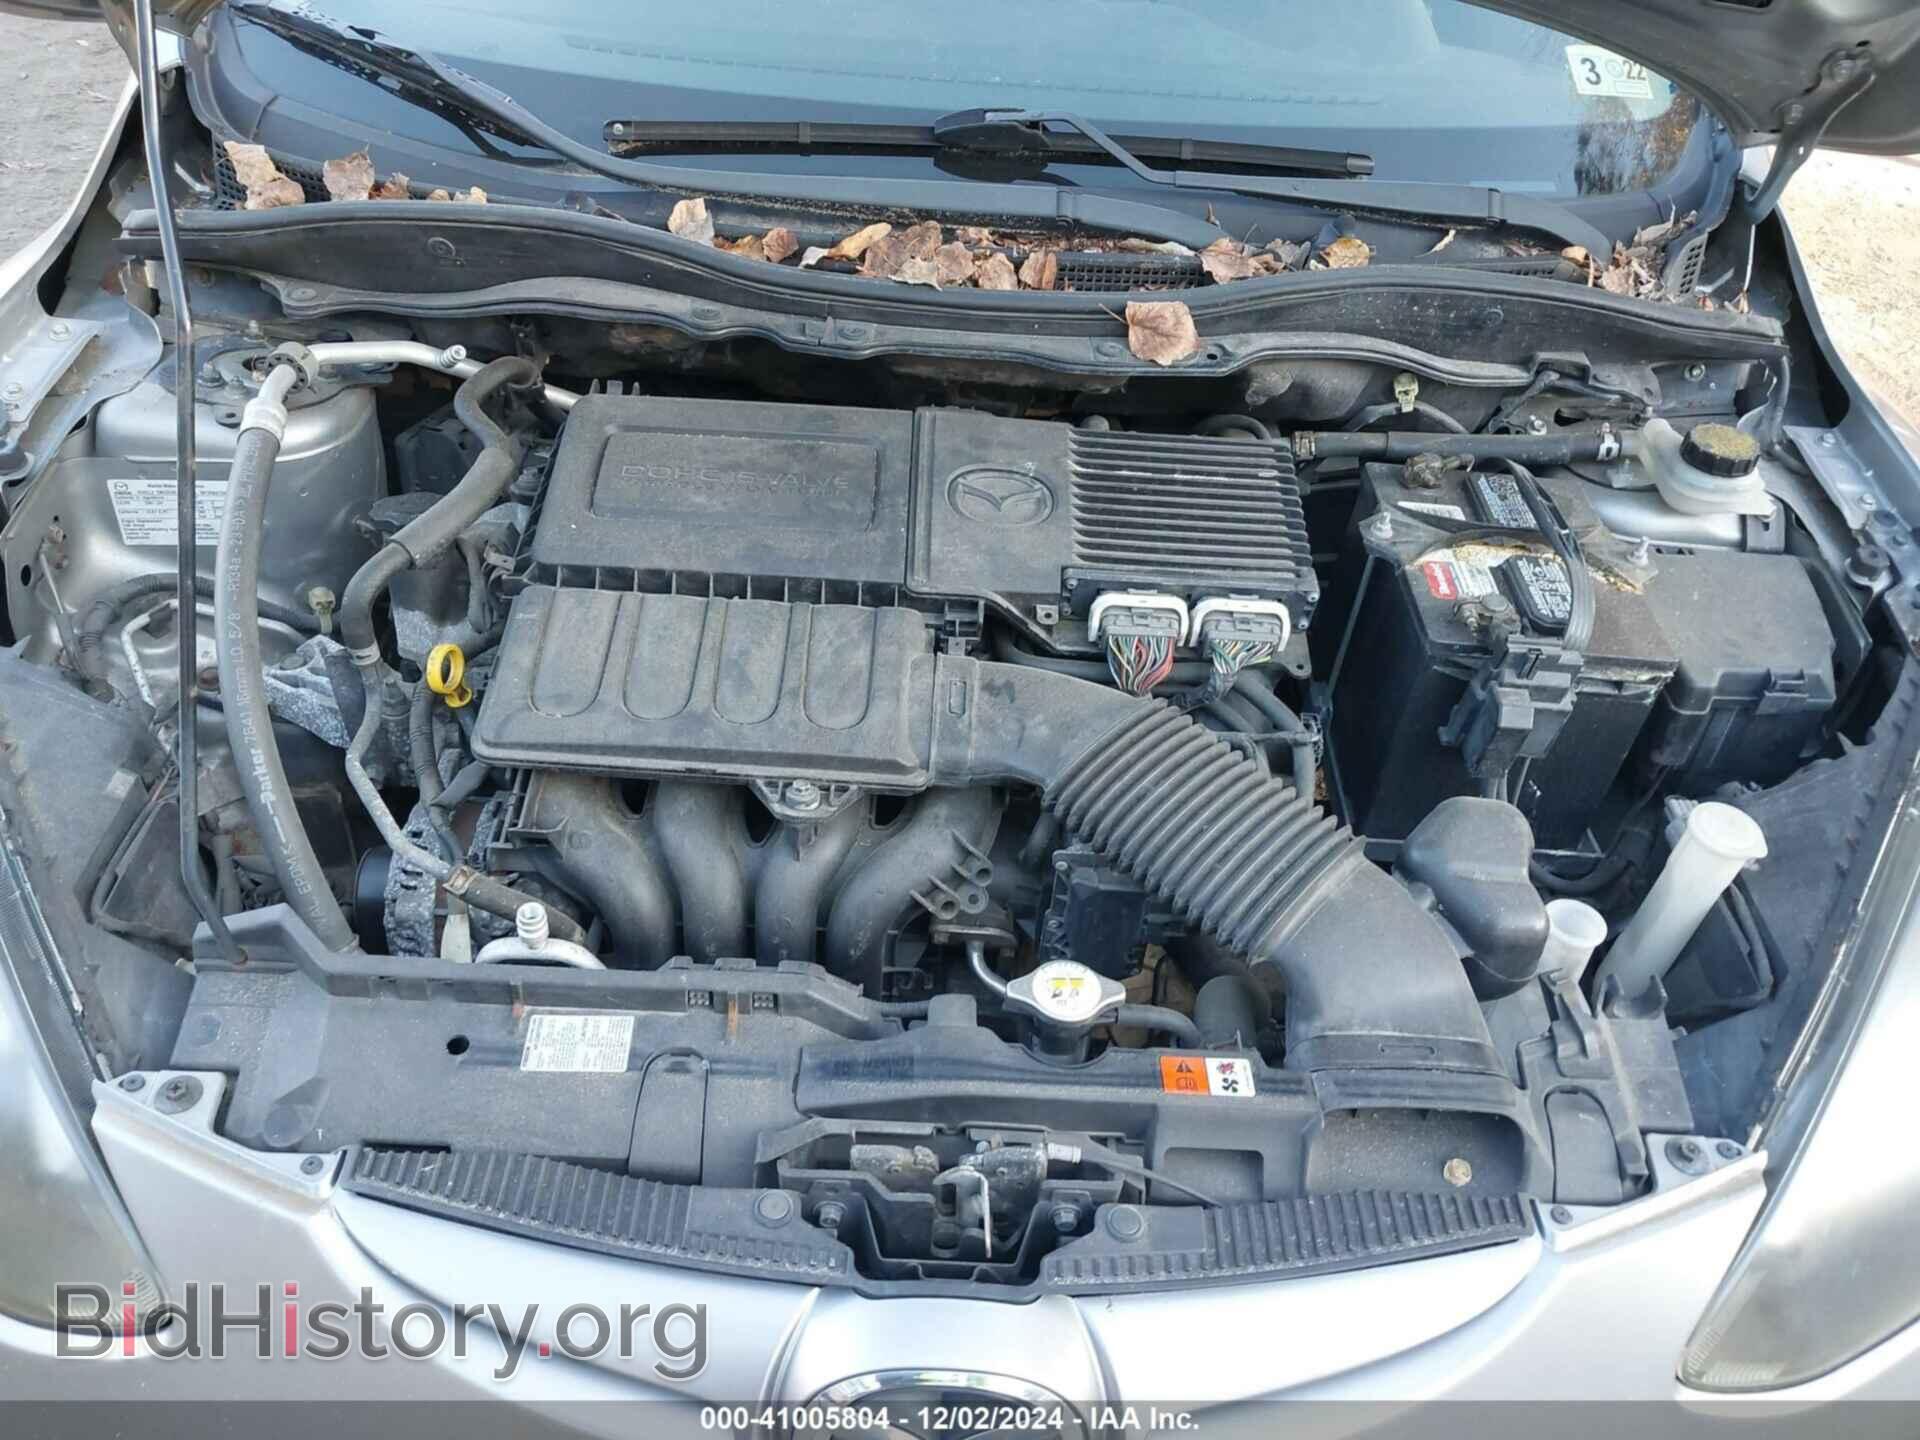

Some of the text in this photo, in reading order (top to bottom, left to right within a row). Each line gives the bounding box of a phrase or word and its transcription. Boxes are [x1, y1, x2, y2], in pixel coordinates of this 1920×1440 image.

[1580, 57, 1602, 86] 3
[621, 464, 721, 483] DOHC
[249, 748, 278, 803] Parker
